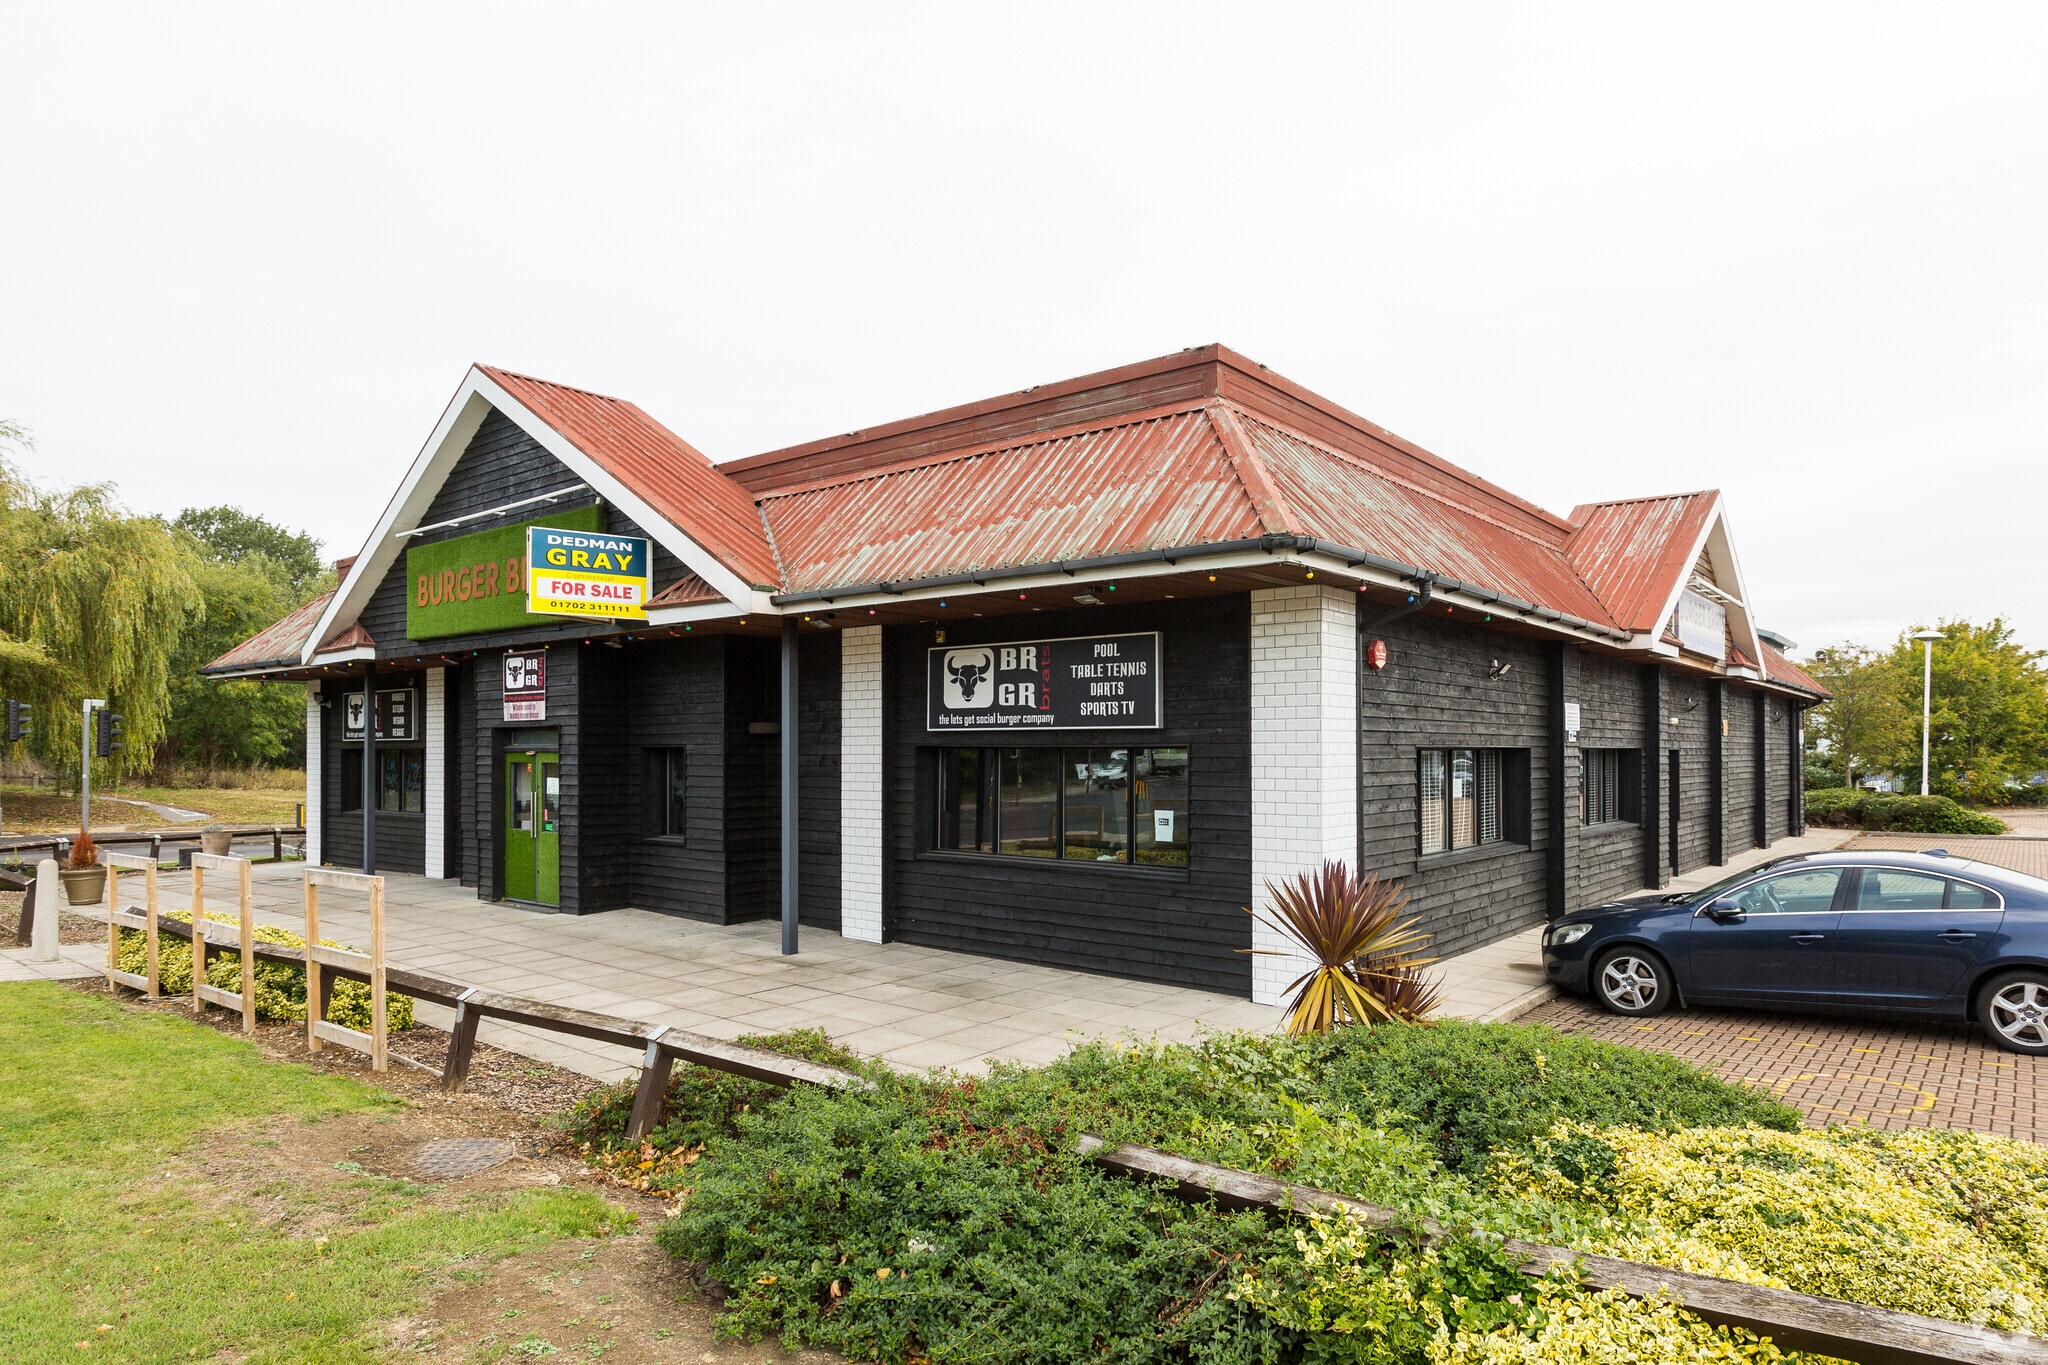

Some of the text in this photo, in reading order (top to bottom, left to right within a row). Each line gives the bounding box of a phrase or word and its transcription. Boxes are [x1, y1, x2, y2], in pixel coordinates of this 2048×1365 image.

[547, 534, 632, 552] DEDMAN
[545, 548, 633, 571] GRAY
[417, 561, 500, 608] BURGER
[566, 572, 614, 582] Commercial
[551, 581, 632, 600] FOR SALE
[550, 601, 629, 612] 01702 311111
[999, 646, 1038, 672] BR
[1094, 643, 1120, 658] POOL
[525, 658, 538, 671] BR
[1070, 661, 1147, 679] TABLE TENNIS
[525, 674, 538, 687] GR
[1039, 644, 1050, 711] brats
[998, 682, 1037, 709] GR
[1090, 681, 1125, 697] DARTS
[1080, 700, 1135, 717] SPORTS TV
[938, 712, 1055, 727] the lets get social burger company
